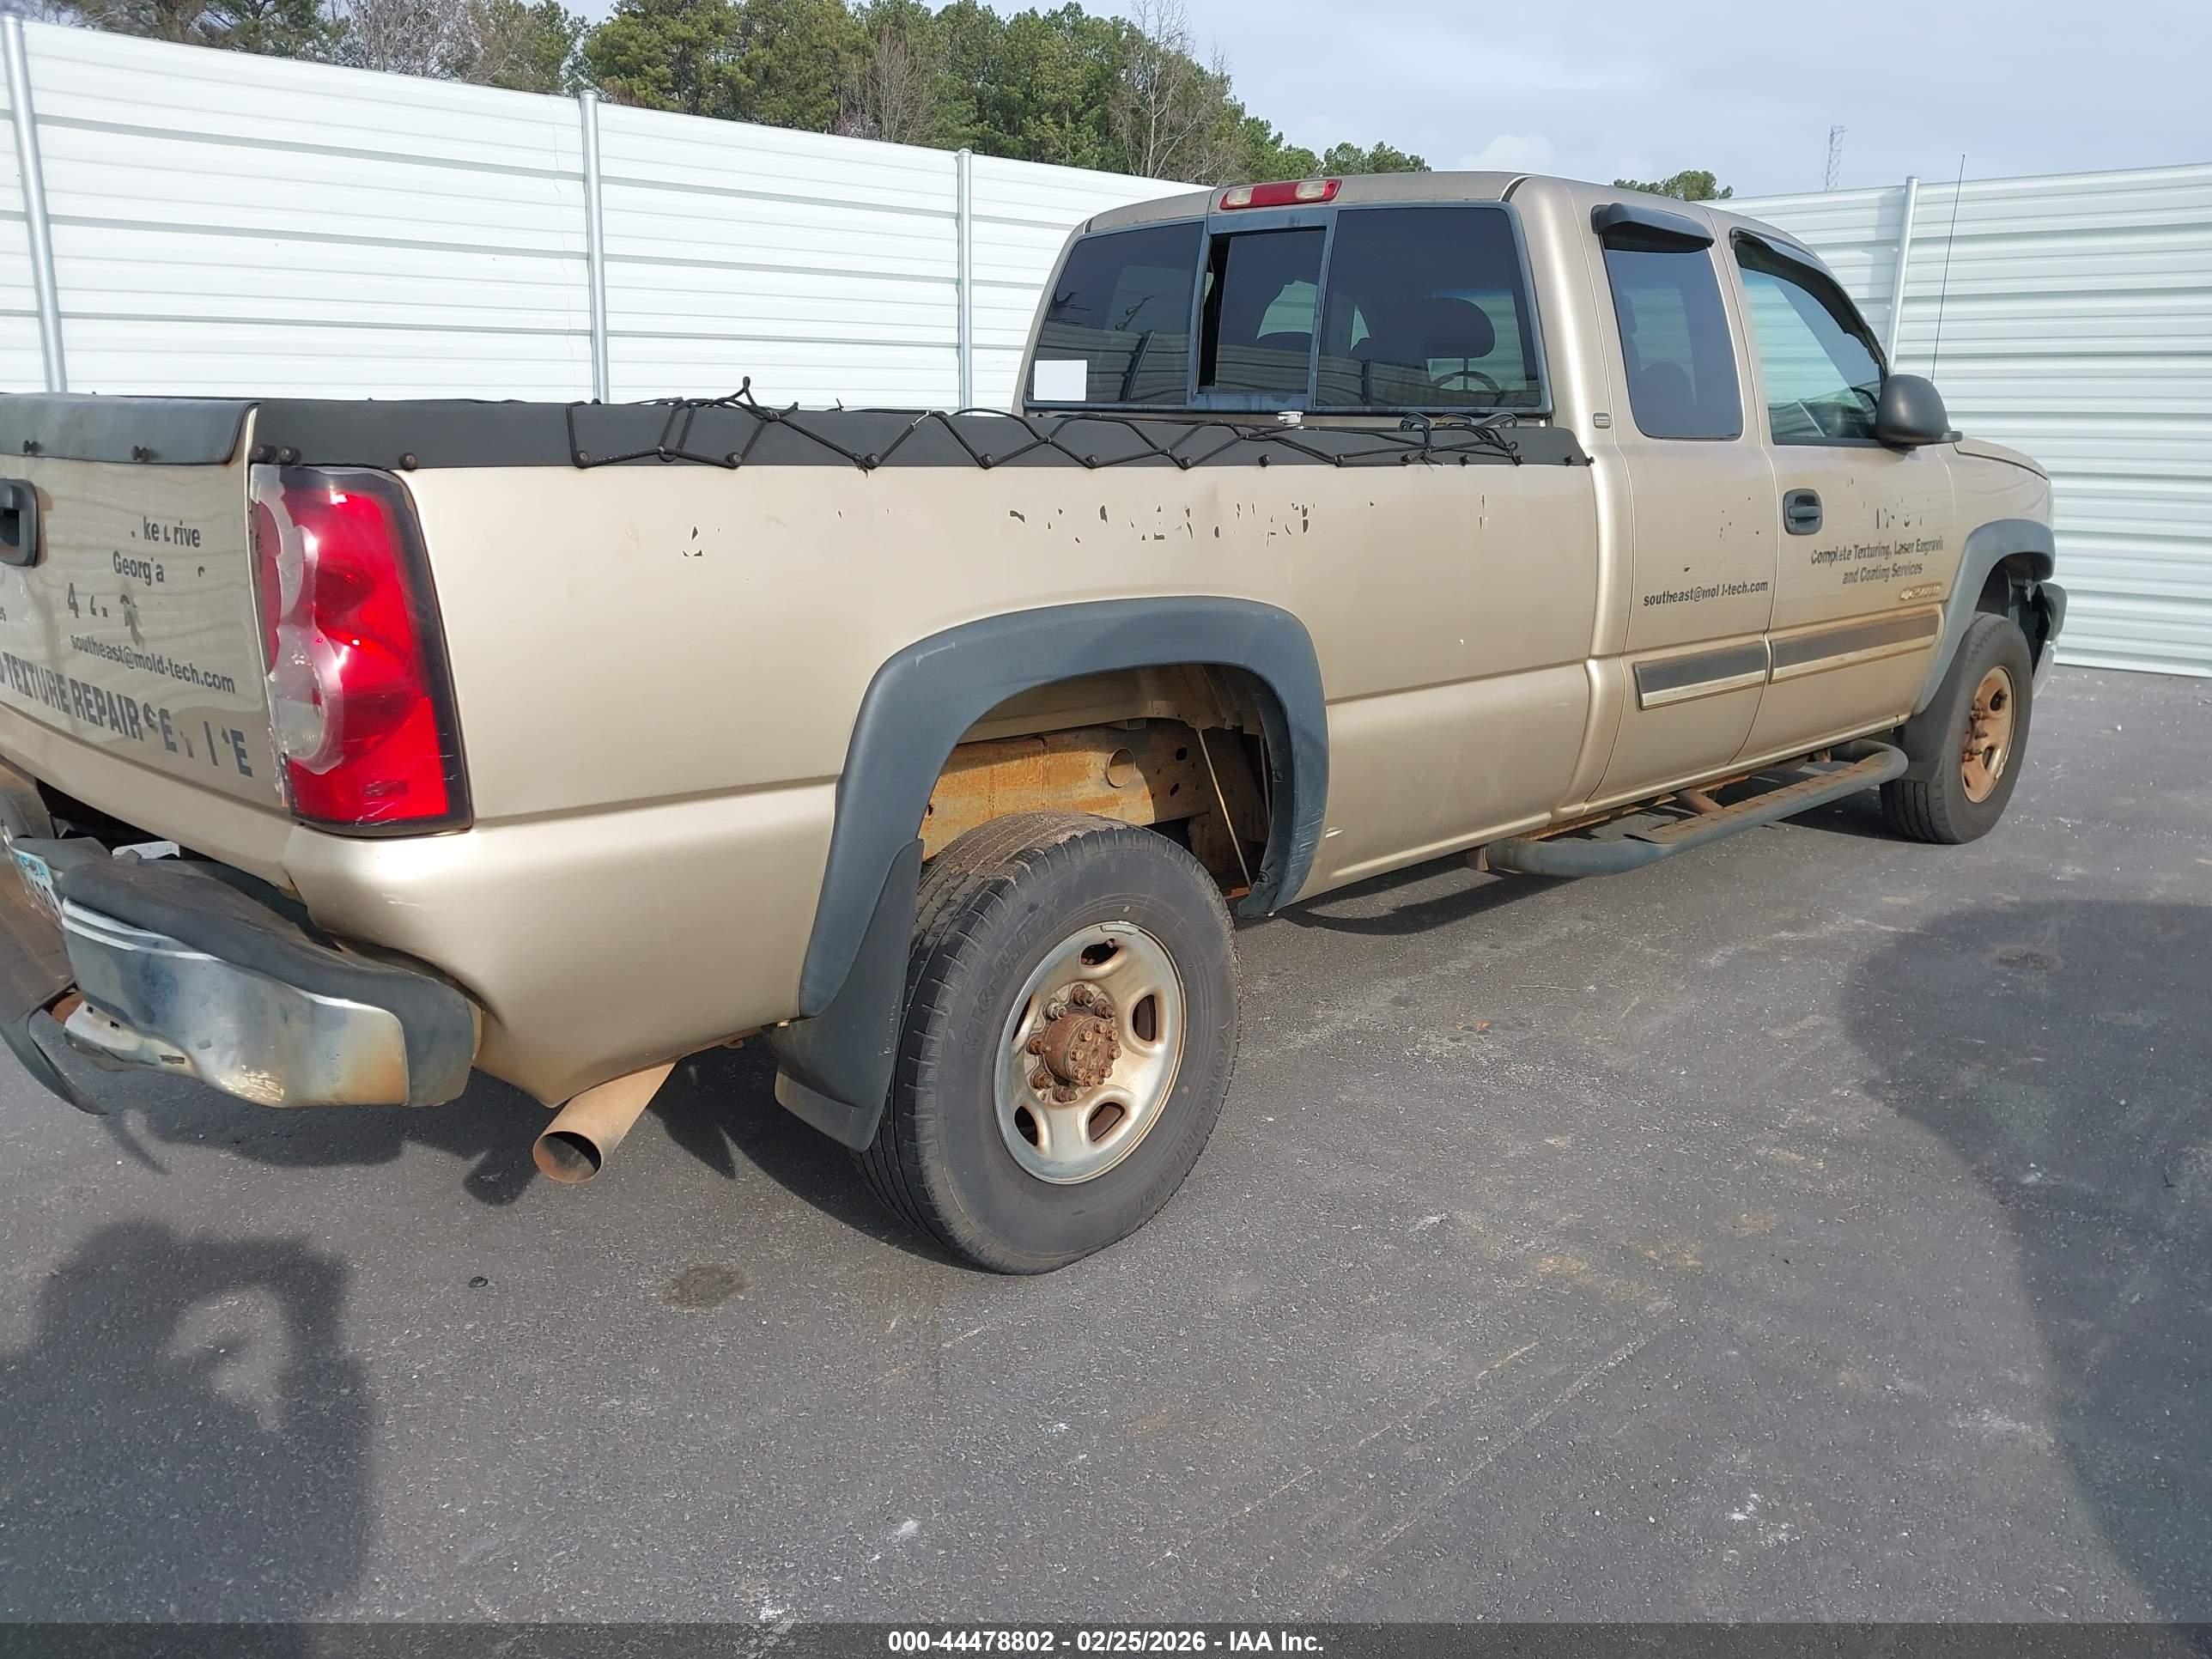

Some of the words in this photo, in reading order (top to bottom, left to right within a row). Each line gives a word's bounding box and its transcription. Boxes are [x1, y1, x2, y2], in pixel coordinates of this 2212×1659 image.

[1842, 568, 1860, 585] and
[1860, 564, 1891, 582] Coating
[1892, 561, 1923, 578] Services
[70, 634, 236, 694] southeast@mold-tech.com
[2, 651, 71, 715] TEXTURE
[69, 678, 145, 742] REPAIR
